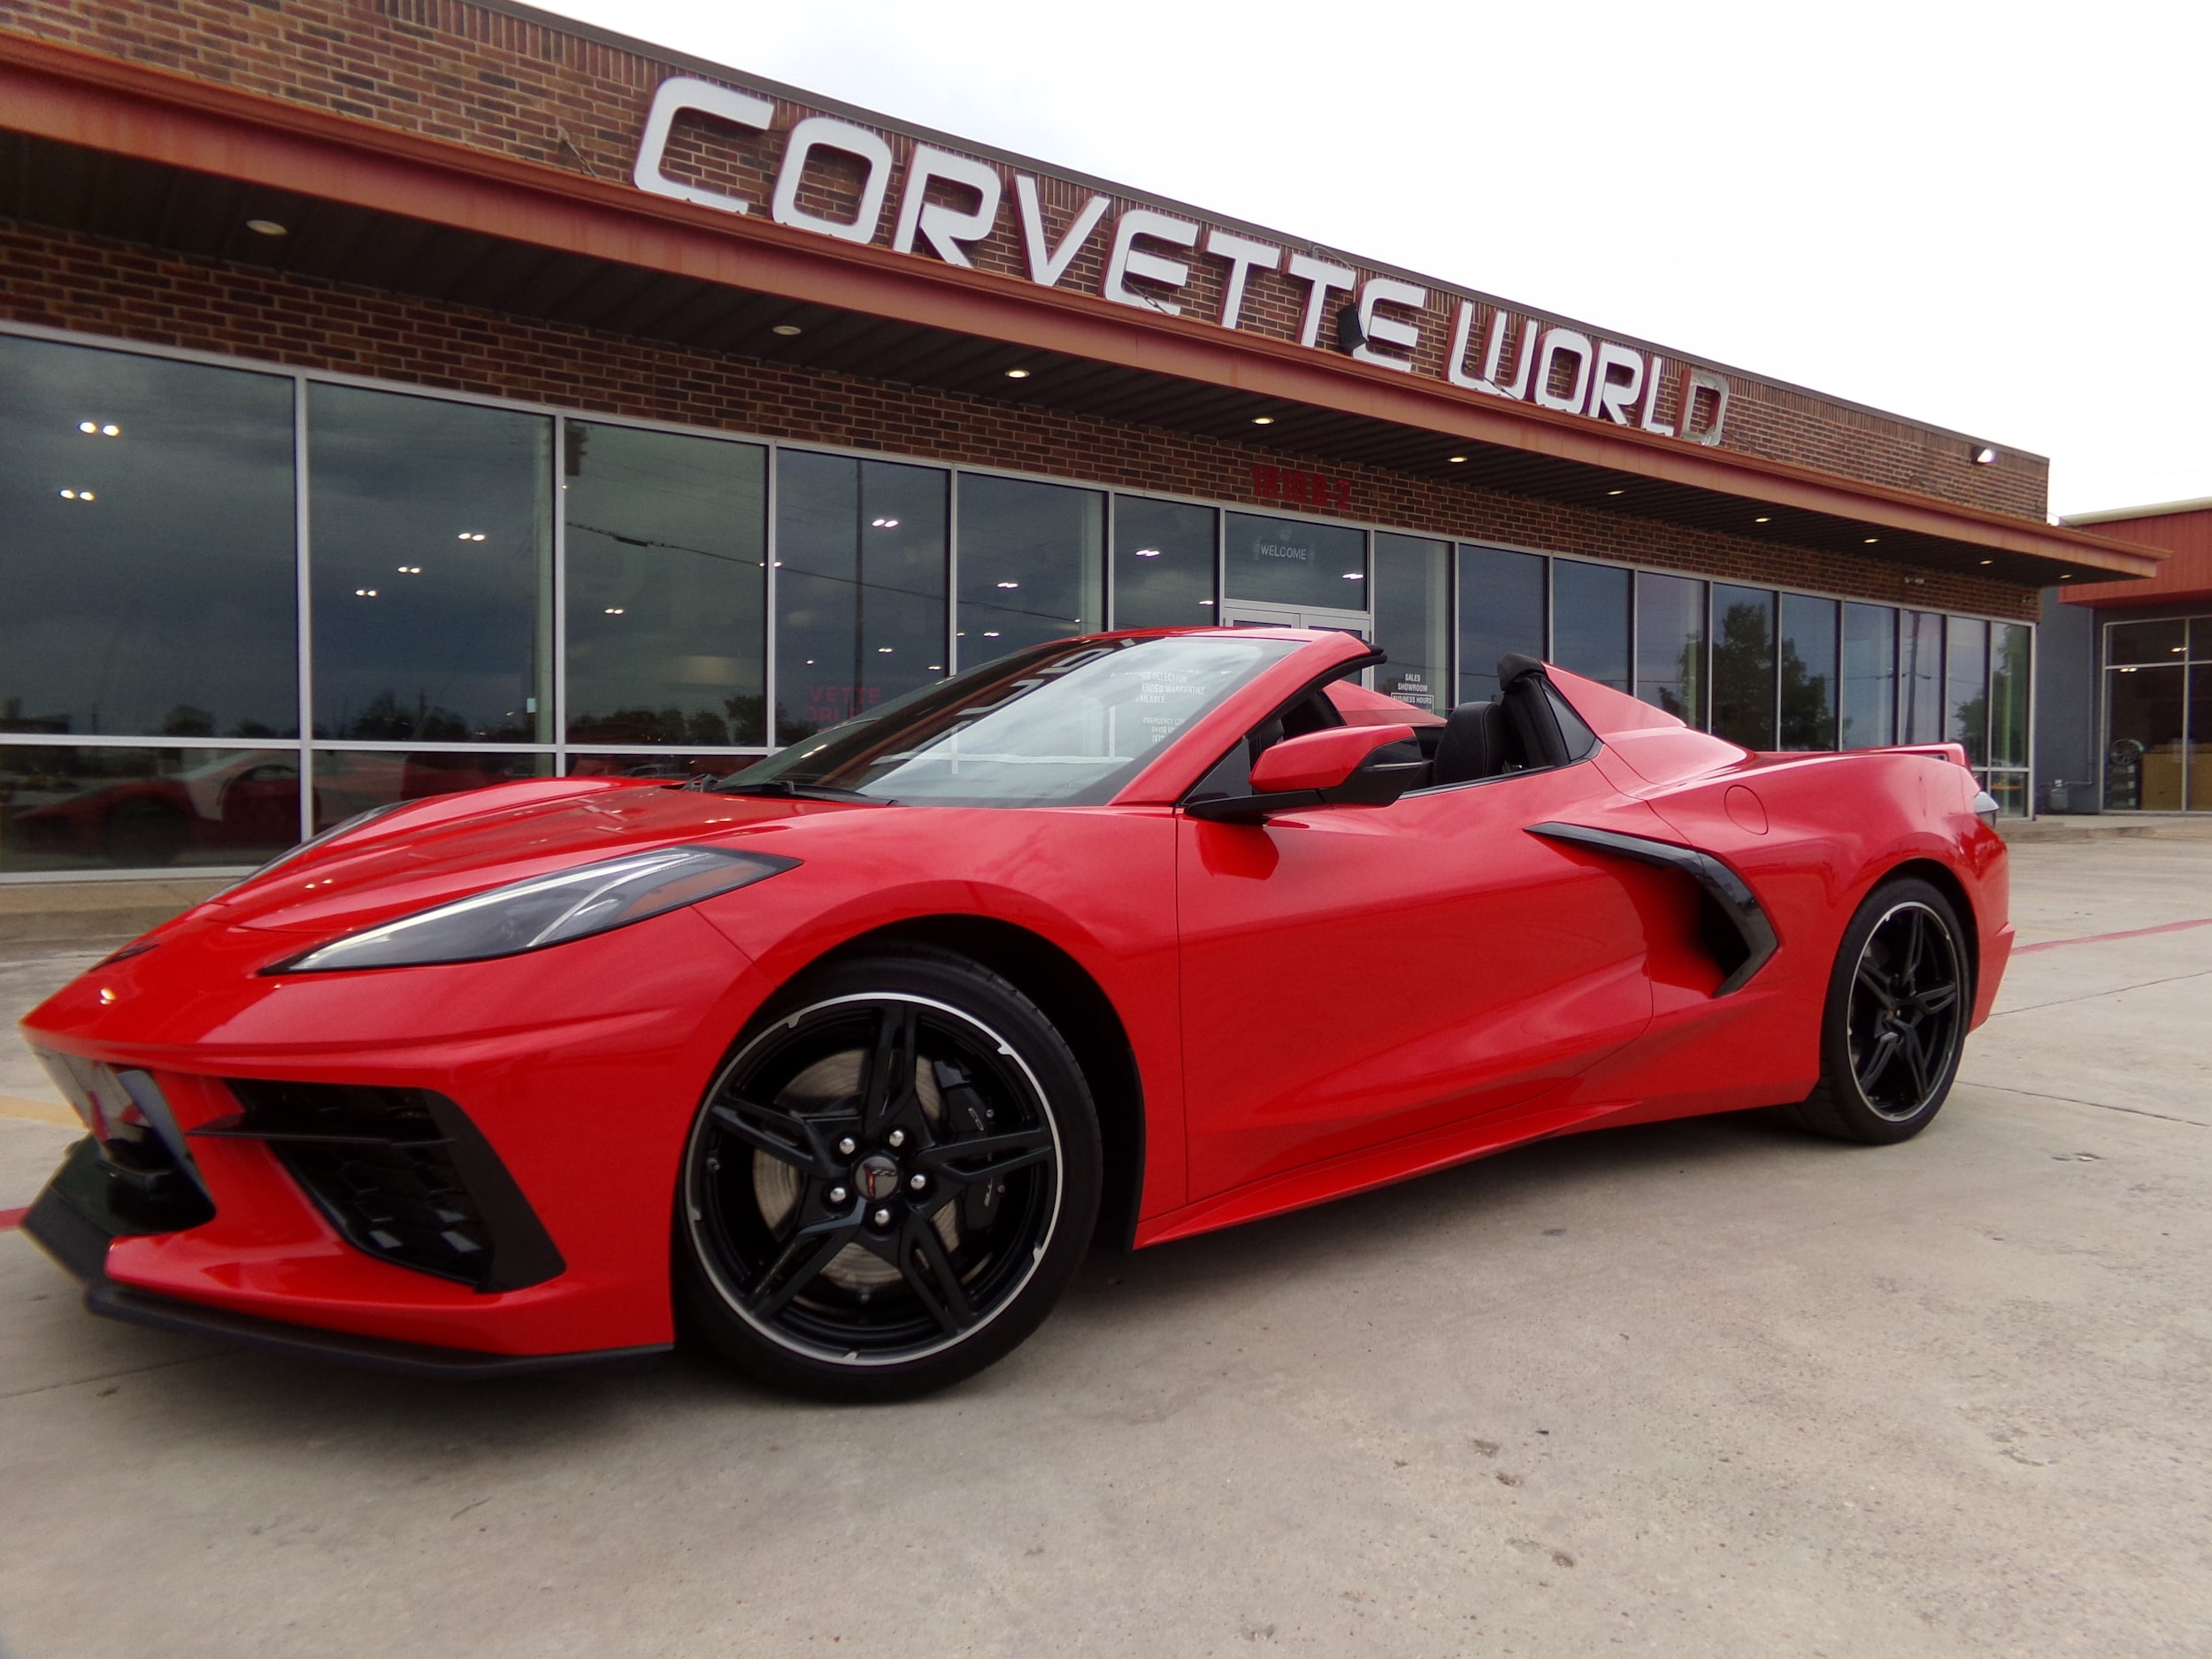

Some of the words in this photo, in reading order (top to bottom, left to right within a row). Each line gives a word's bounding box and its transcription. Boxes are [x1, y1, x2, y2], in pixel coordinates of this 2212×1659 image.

[634, 75, 1426, 373] CORVETTE
[1442, 301, 1730, 446] WORLD
[1261, 544, 1307, 560] WELCOME
